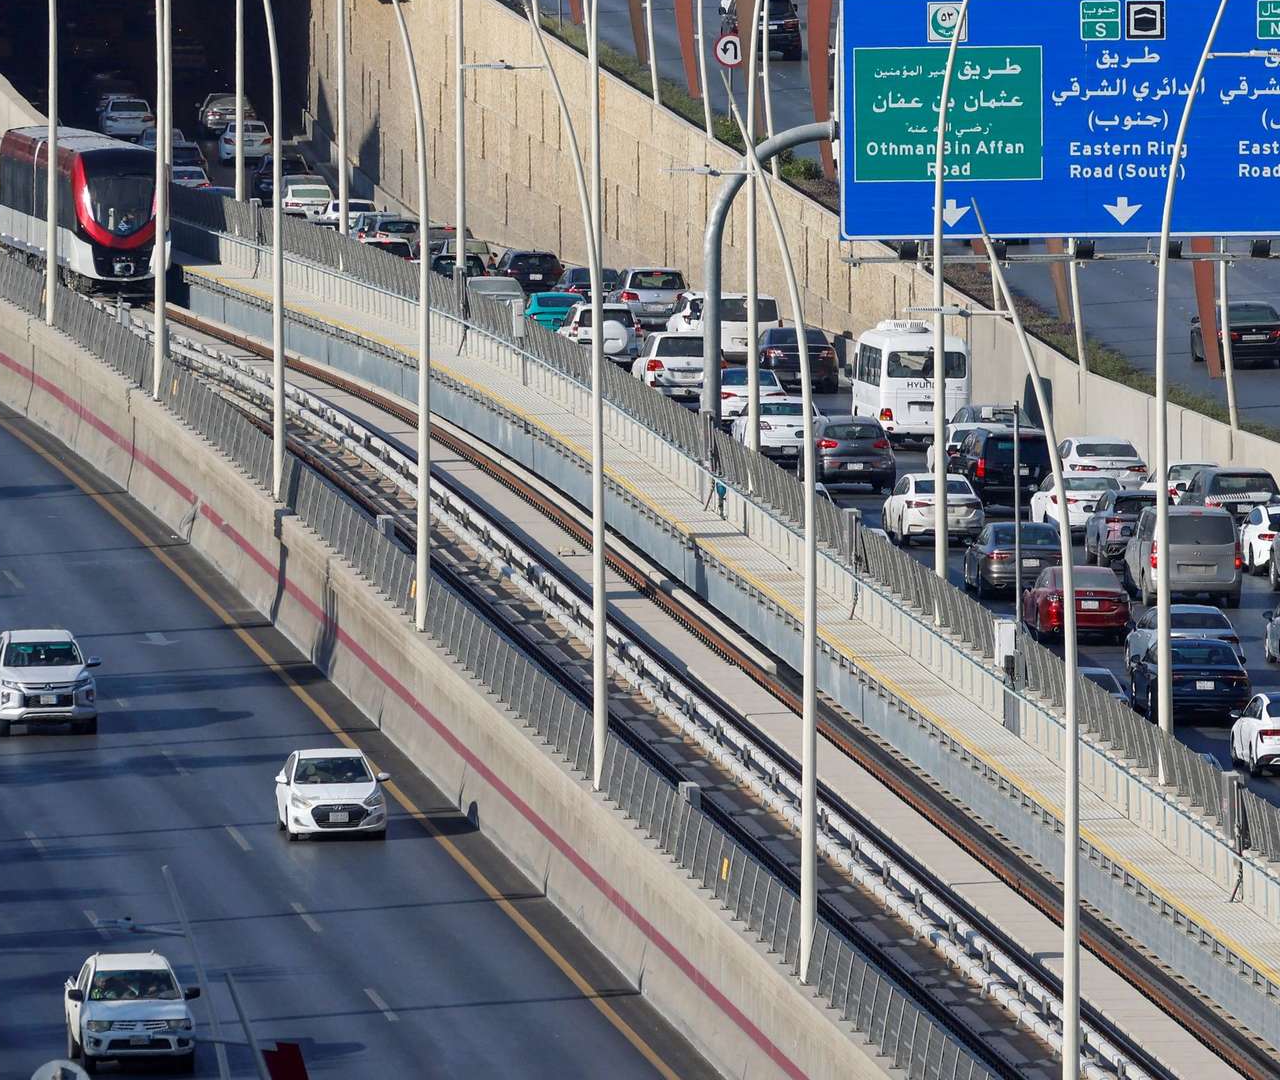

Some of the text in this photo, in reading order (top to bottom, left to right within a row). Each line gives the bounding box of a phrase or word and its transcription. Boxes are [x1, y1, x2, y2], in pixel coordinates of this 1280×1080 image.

[1083, 6, 1117, 16] جنوب
[1095, 23, 1107, 38] S
[1096, 45, 1161, 69] طريق
[874, 56, 1023, 80] طريق مير المؤمنين
[1052, 77, 1206, 106] ادائري الشرقي
[872, 88, 1024, 113] عثمان بن عفان
[1087, 109, 1168, 132] (جنوب)
[866, 140, 1025, 156] Othman Bin Affan
[1070, 141, 1188, 158] Eastern Ring
[1070, 163, 1186, 180] Road (Sout)
[906, 381, 935, 389] HYUN
